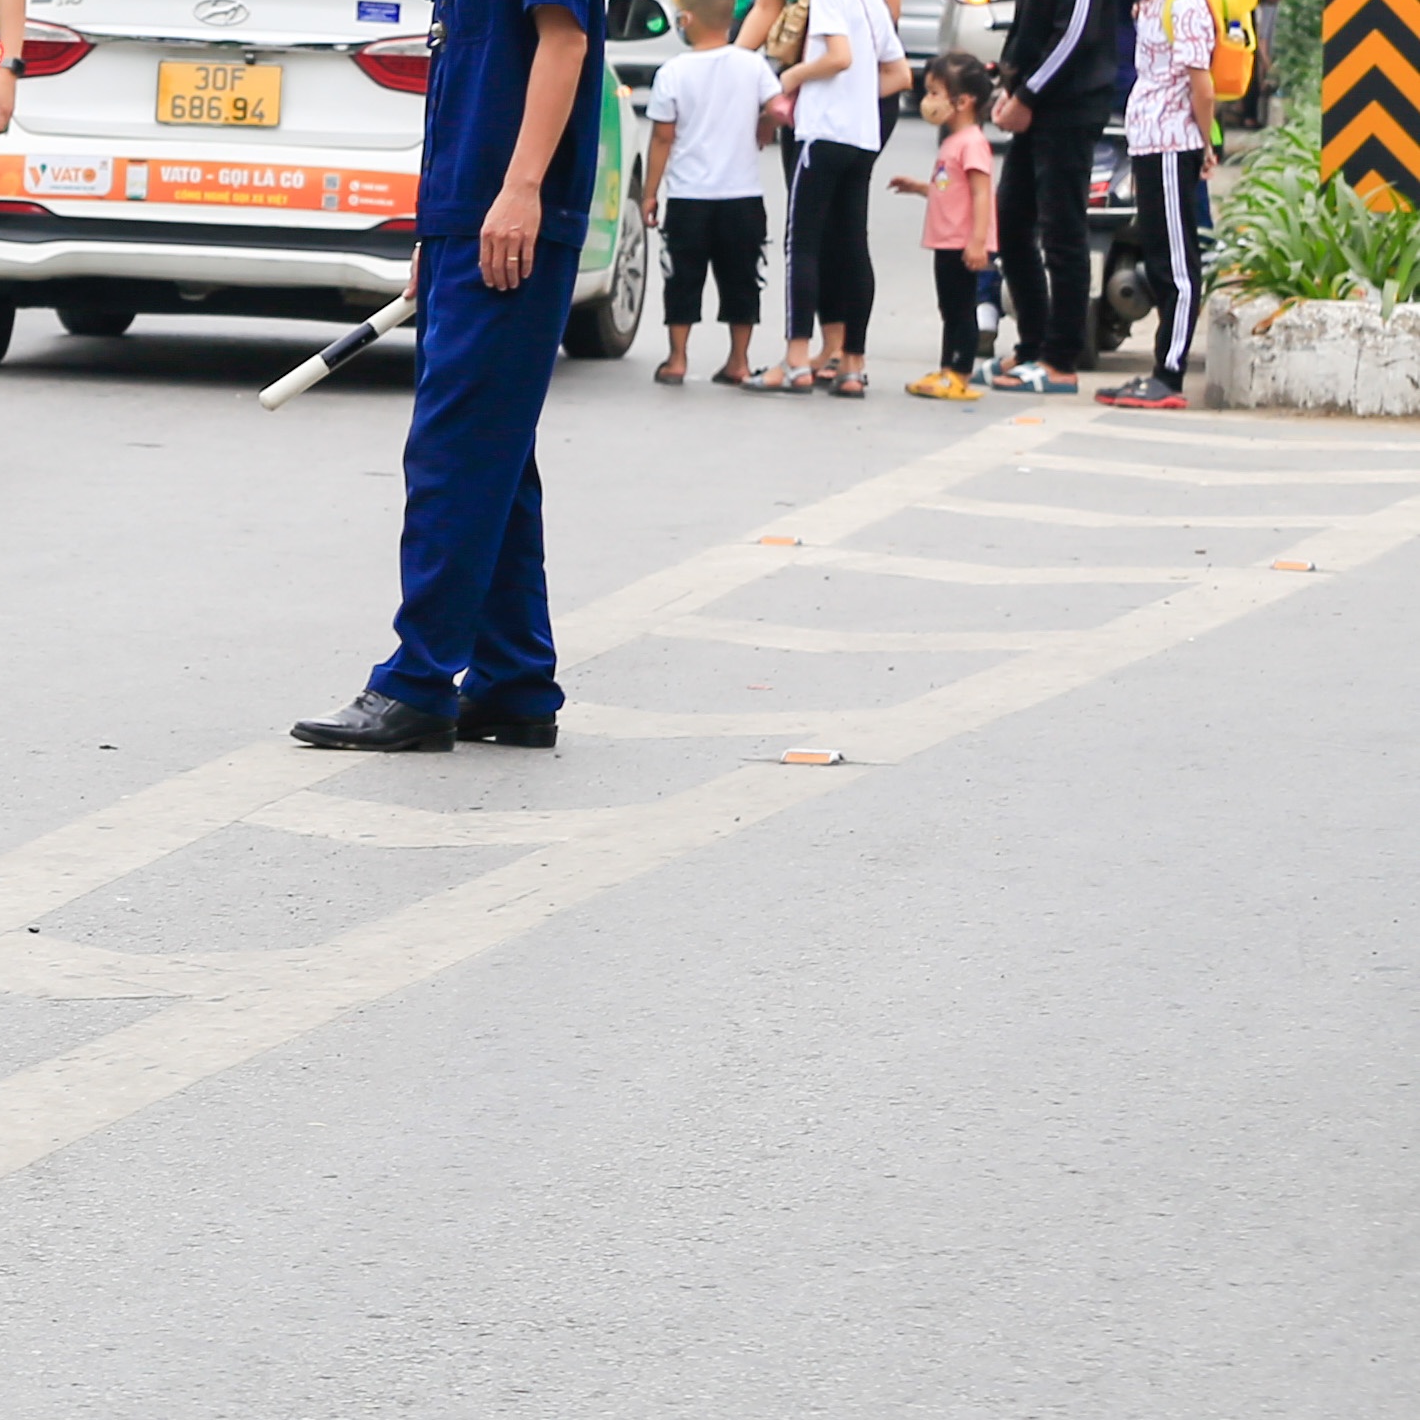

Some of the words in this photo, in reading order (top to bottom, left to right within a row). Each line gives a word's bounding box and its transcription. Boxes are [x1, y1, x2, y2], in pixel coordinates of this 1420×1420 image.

[194, 66, 246, 92] 30F
[171, 94, 265, 122] 686.94
[51, 167, 97, 183] VATO
[161, 166, 202, 184] VATO
[218, 168, 248, 188] GỌI
[253, 166, 275, 187] LÀ
[279, 168, 305, 189] CÓ
